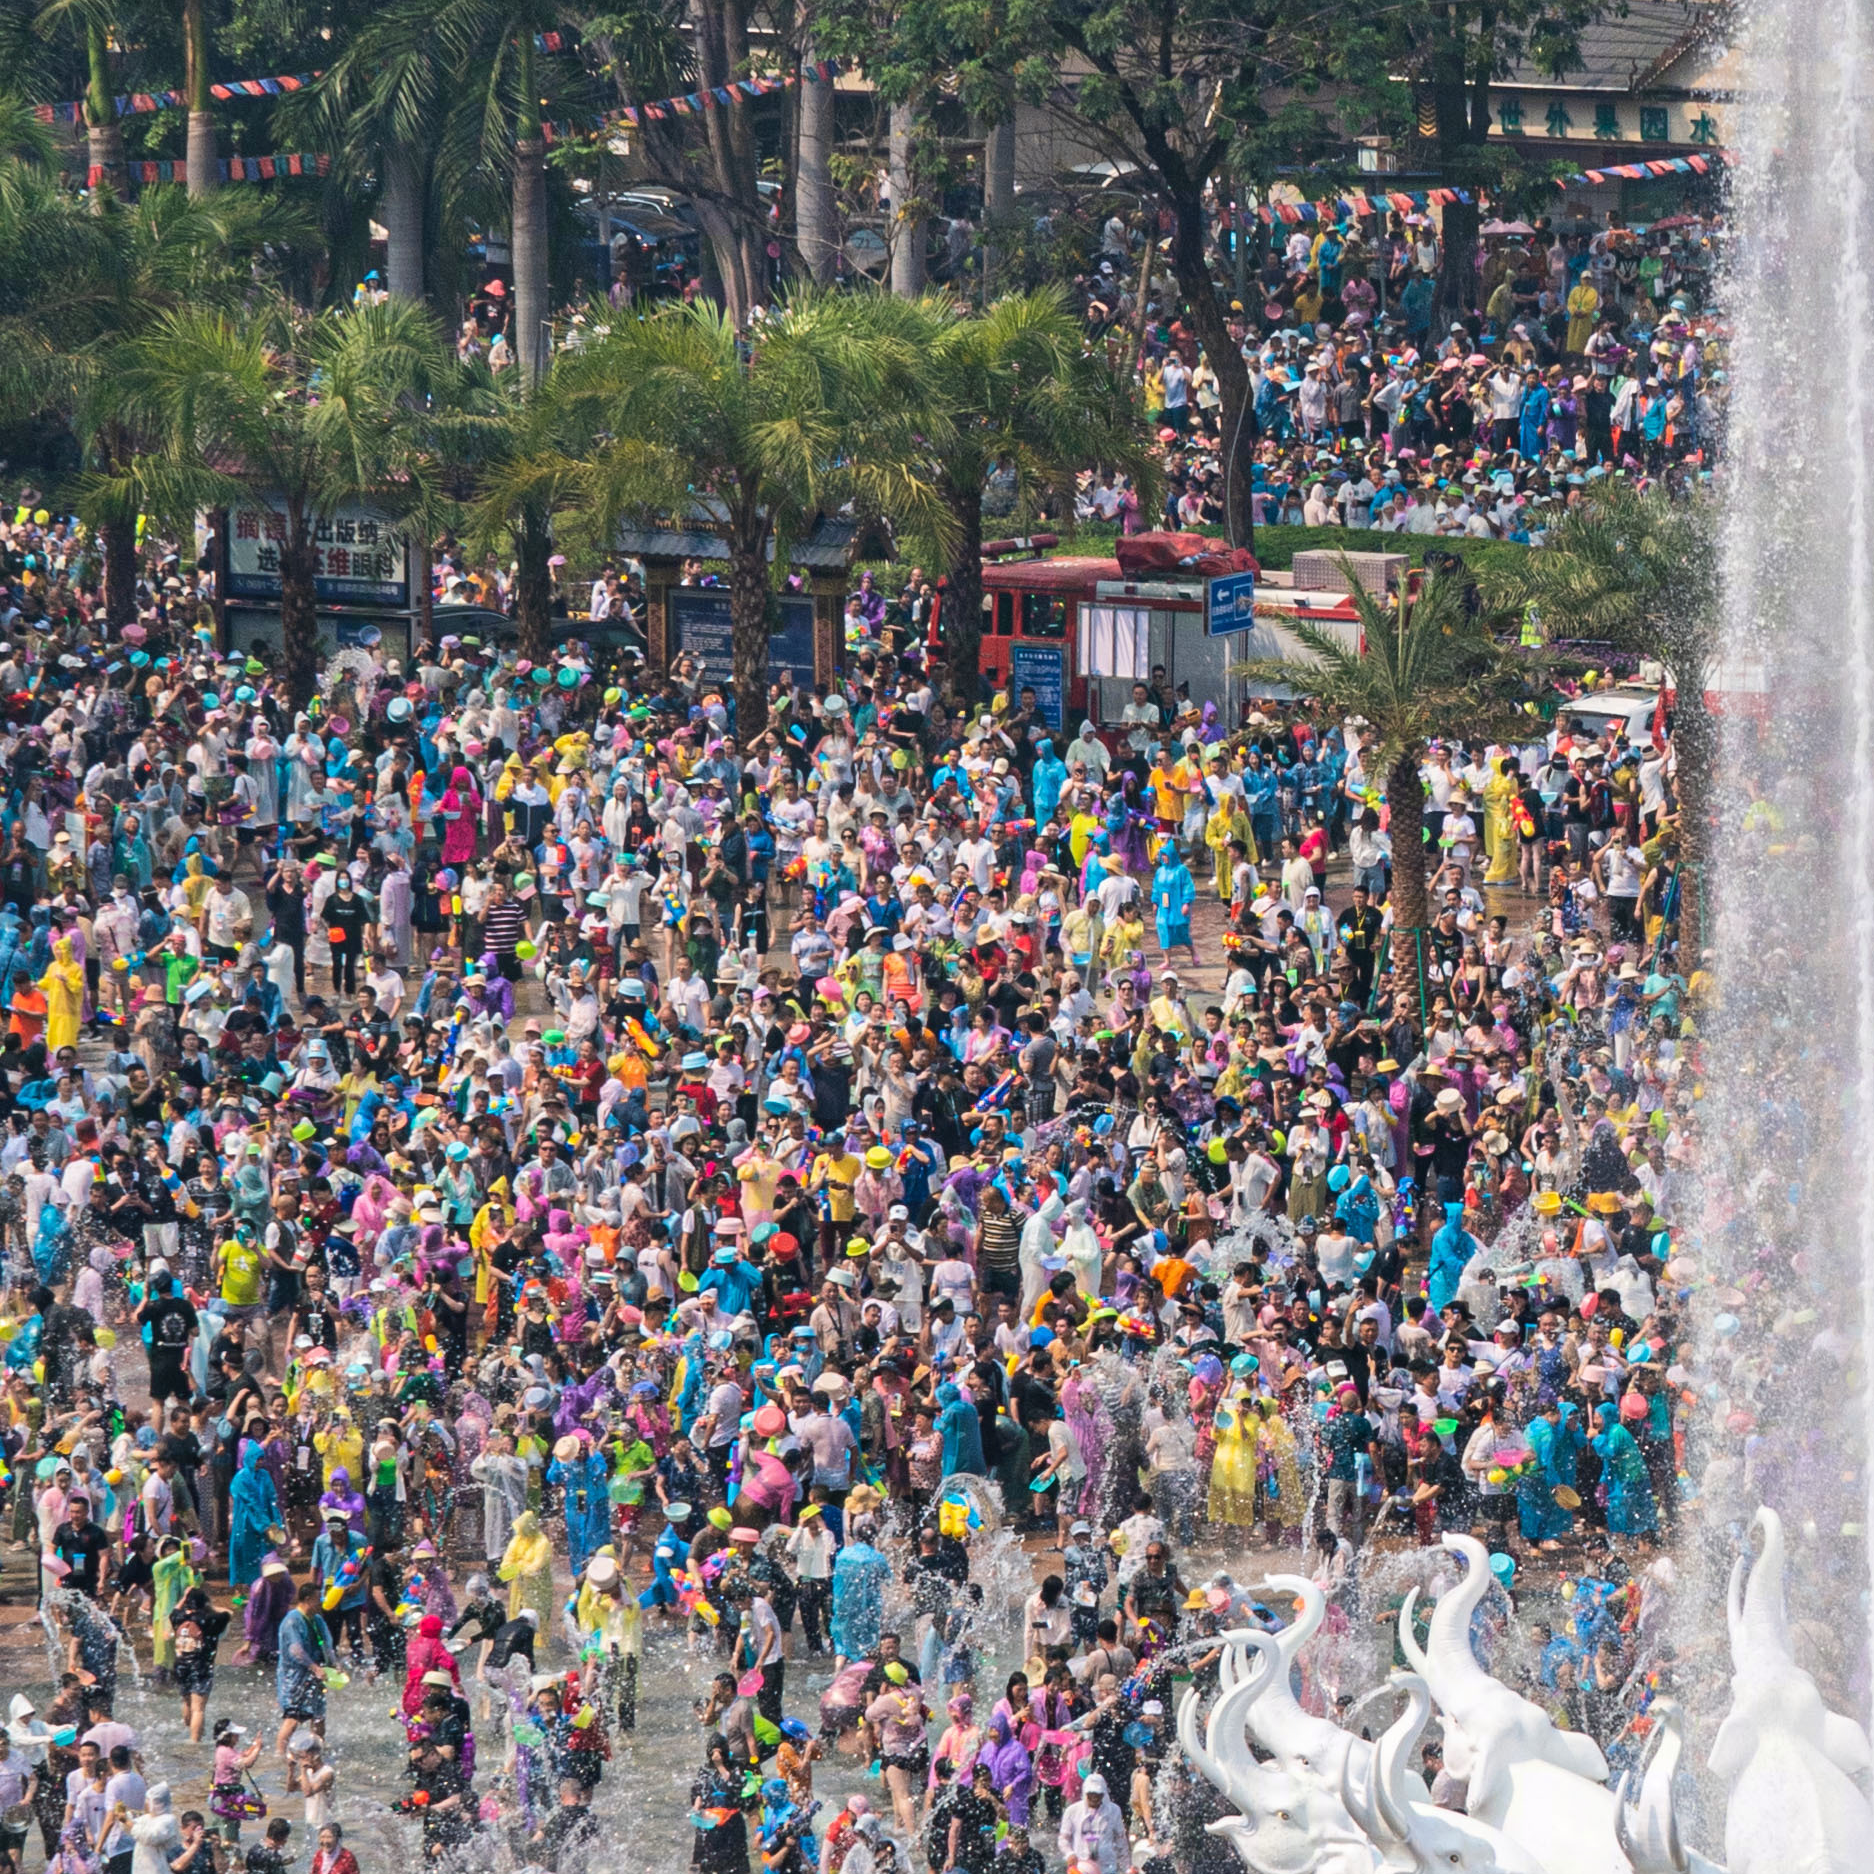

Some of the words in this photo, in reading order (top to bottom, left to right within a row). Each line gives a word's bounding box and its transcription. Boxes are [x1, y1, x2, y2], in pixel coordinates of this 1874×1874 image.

[236, 510, 379, 545] 摘镜出版纳
[257, 545, 395, 579] 选维眼科
